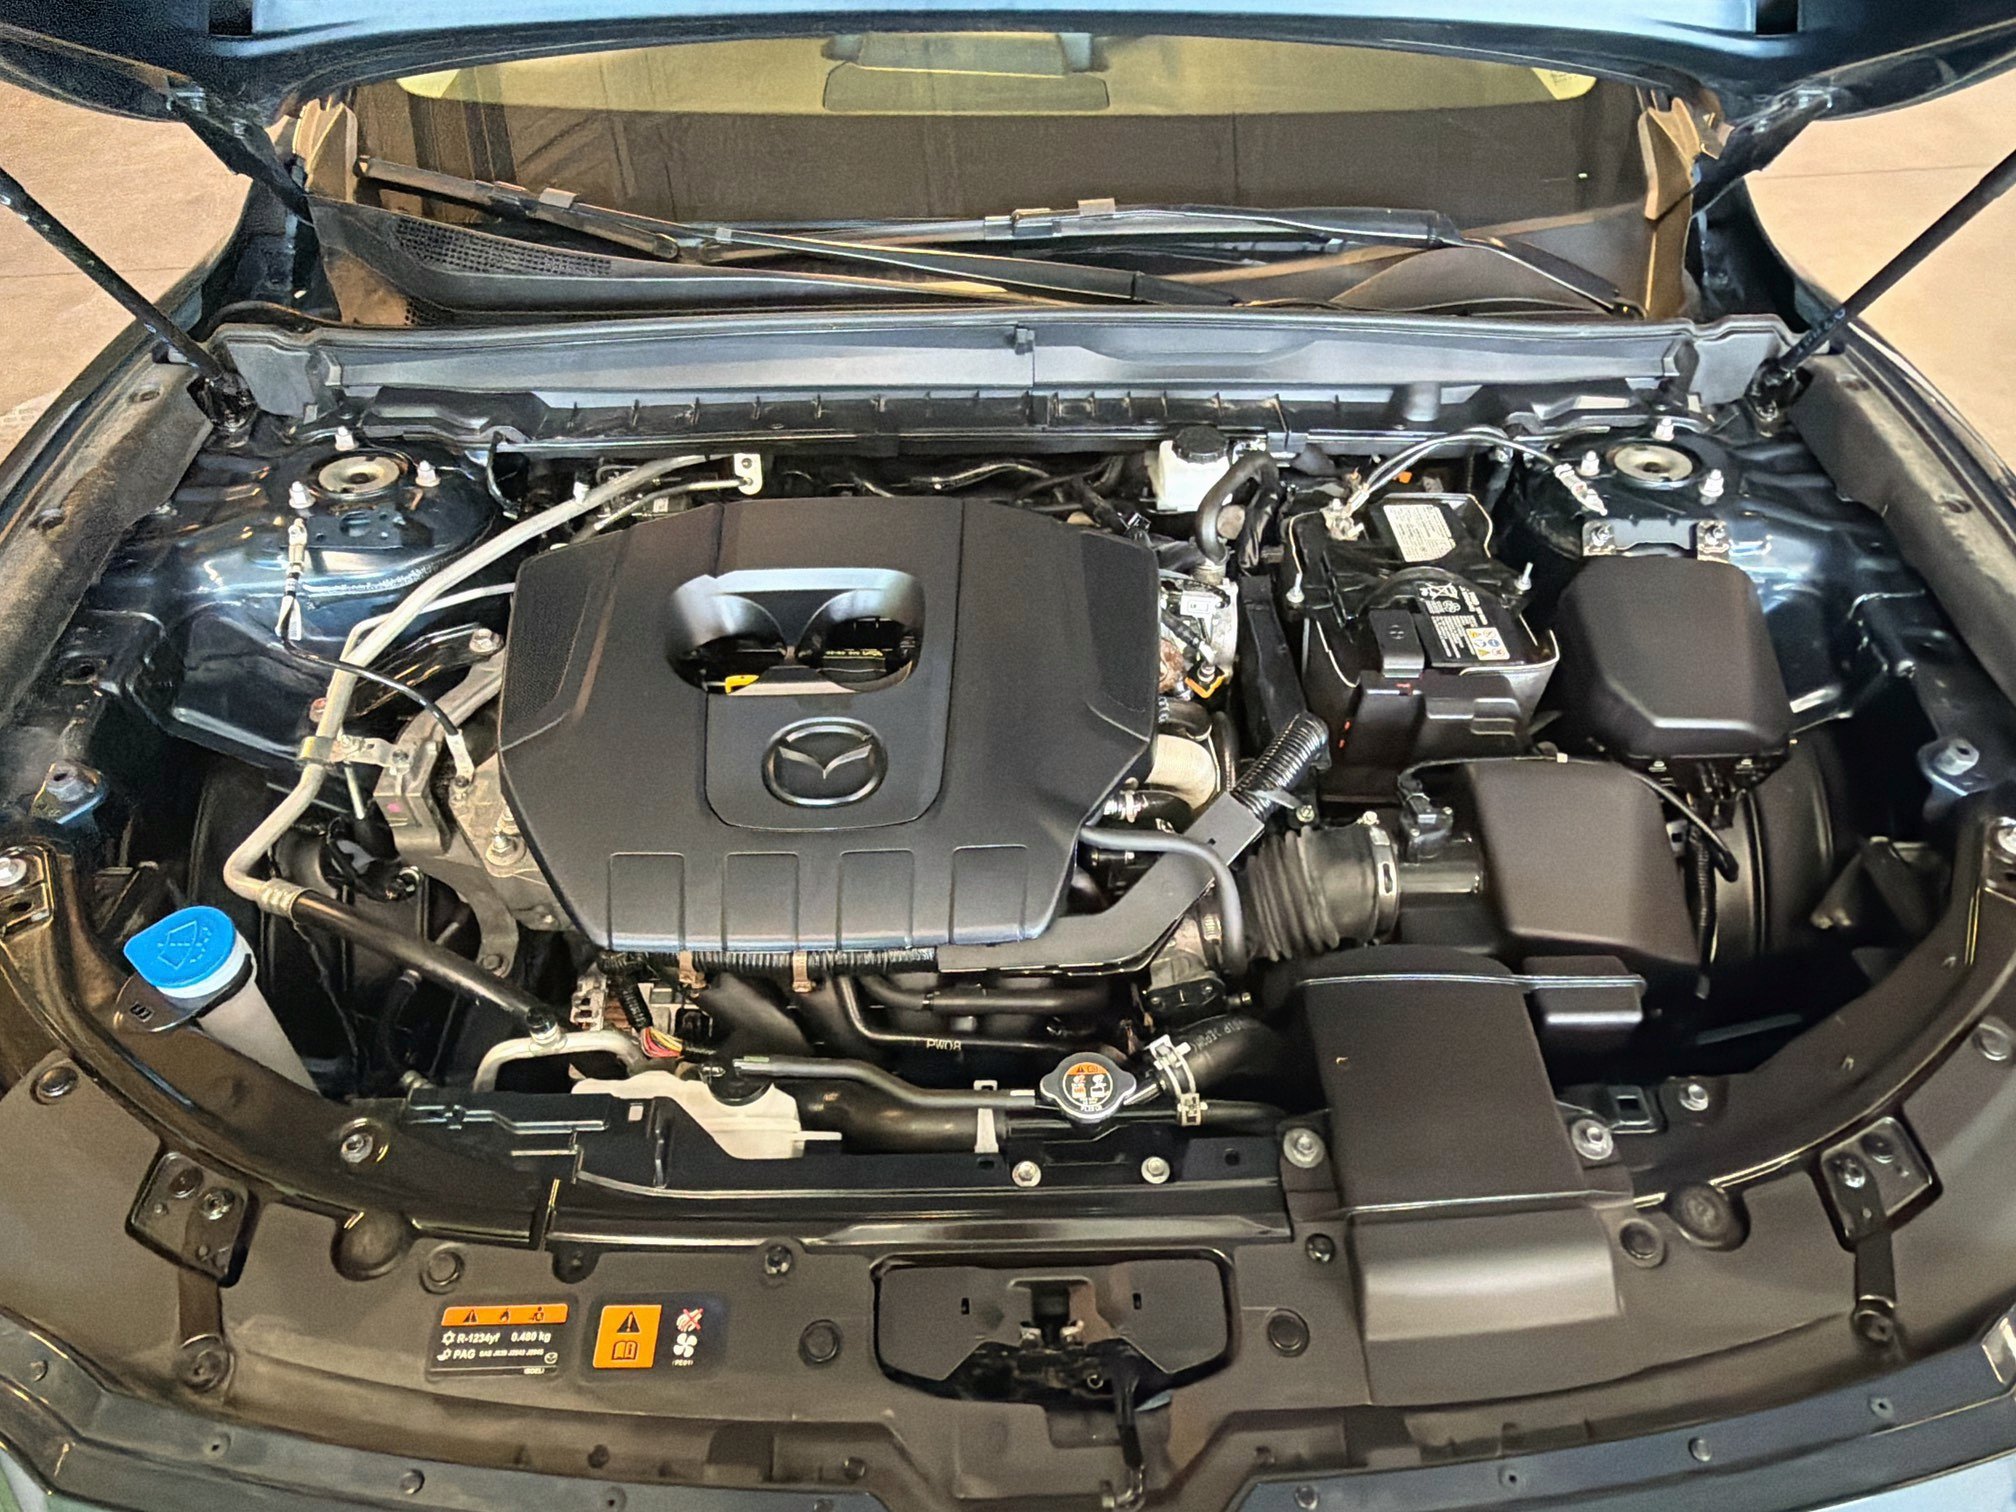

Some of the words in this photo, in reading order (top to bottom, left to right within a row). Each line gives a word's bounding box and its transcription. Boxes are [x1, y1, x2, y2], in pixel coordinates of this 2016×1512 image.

[457, 1332, 501, 1345] R-1234yf
[538, 1331, 552, 1343] kg
[453, 1349, 476, 1360] PAG
